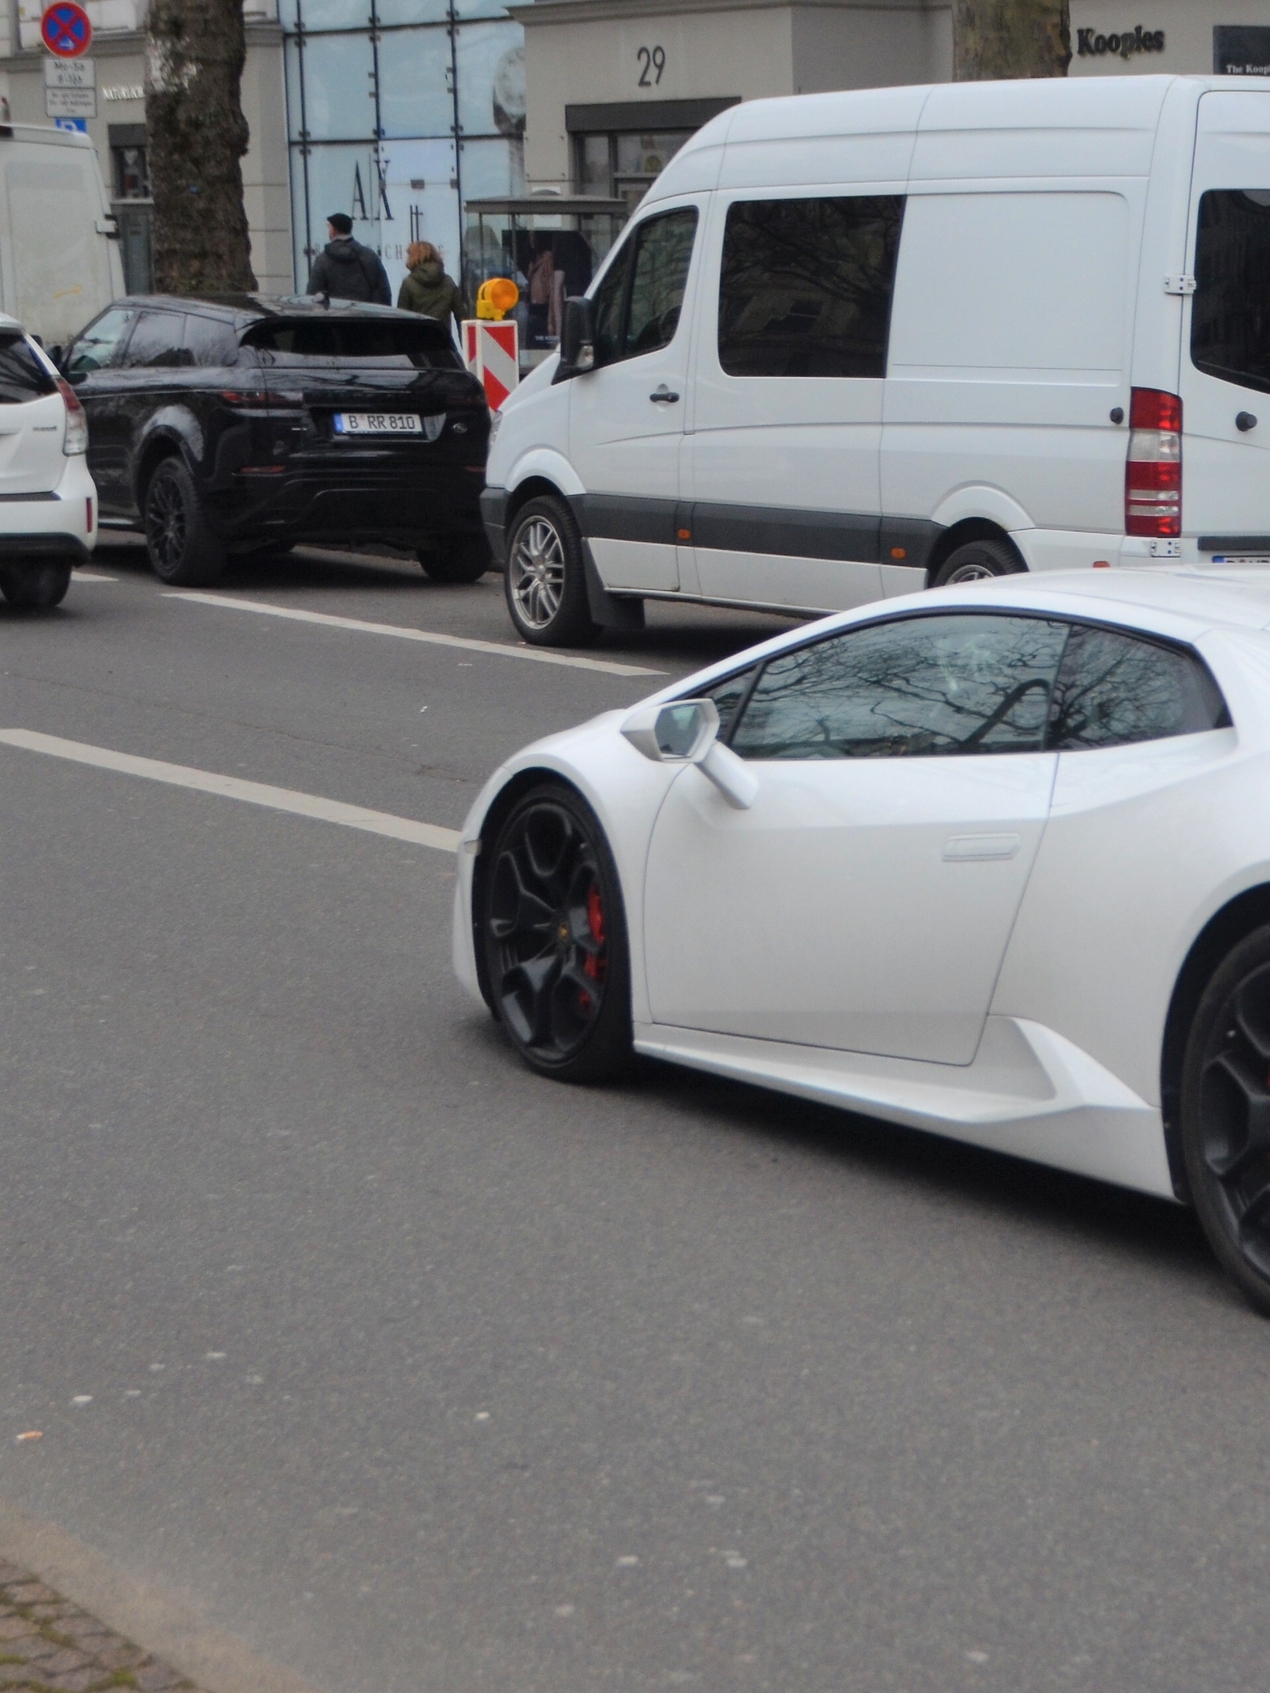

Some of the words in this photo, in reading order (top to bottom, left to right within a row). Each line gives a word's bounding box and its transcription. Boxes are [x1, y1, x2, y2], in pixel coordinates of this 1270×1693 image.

[1077, 24, 1165, 60] Kooples
[637, 45, 666, 88] 29
[1226, 64, 1243, 74] The
[349, 415, 358, 429] B
[366, 415, 387, 429] RR
[390, 415, 416, 430] 810
